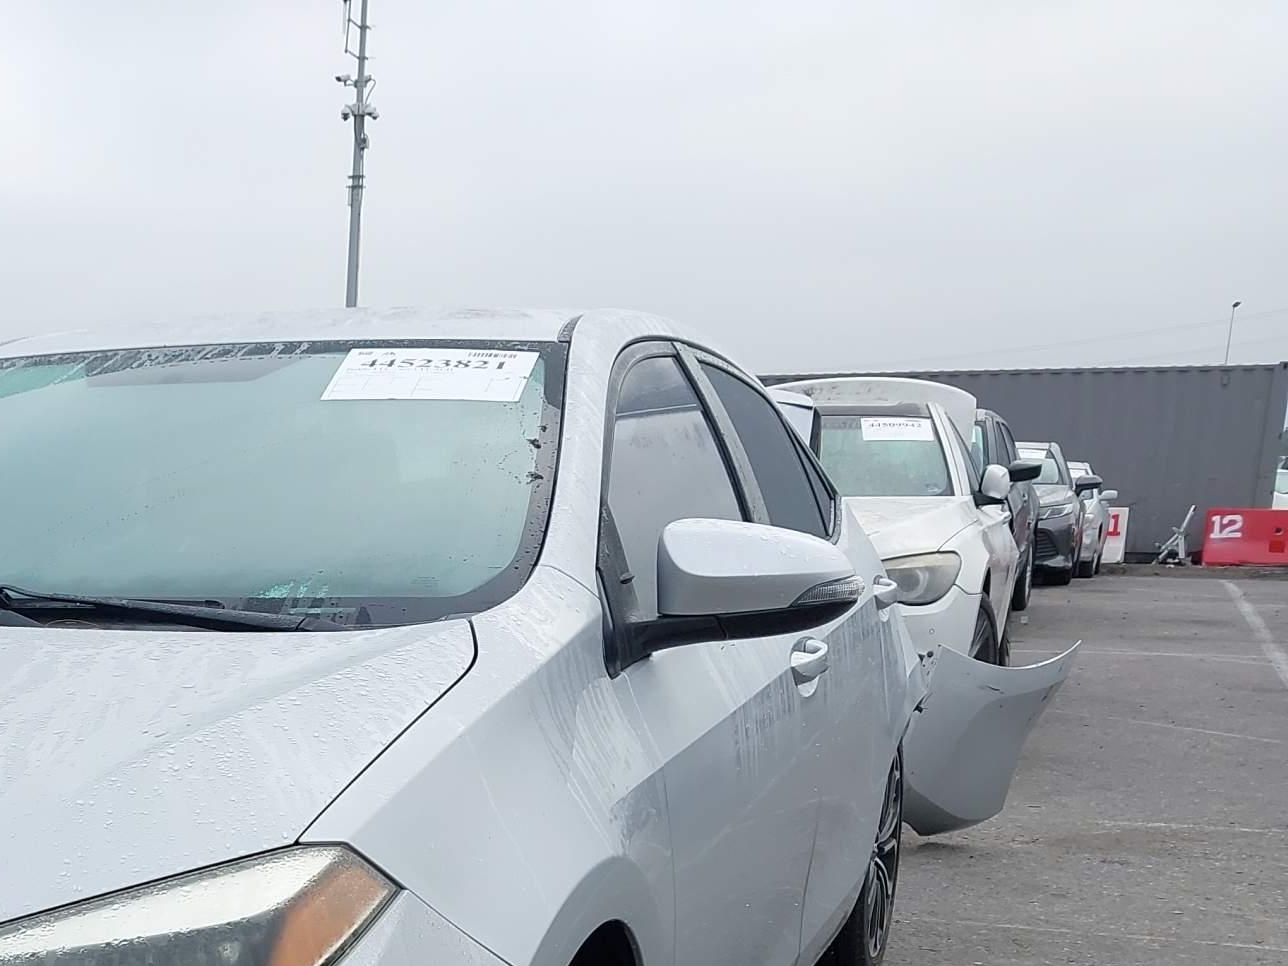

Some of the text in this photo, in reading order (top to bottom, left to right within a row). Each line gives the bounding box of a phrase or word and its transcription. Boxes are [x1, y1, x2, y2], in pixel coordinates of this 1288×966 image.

[361, 358, 506, 370] 44523821
[1106, 513, 1121, 537] 1
[1209, 514, 1244, 539] 12
